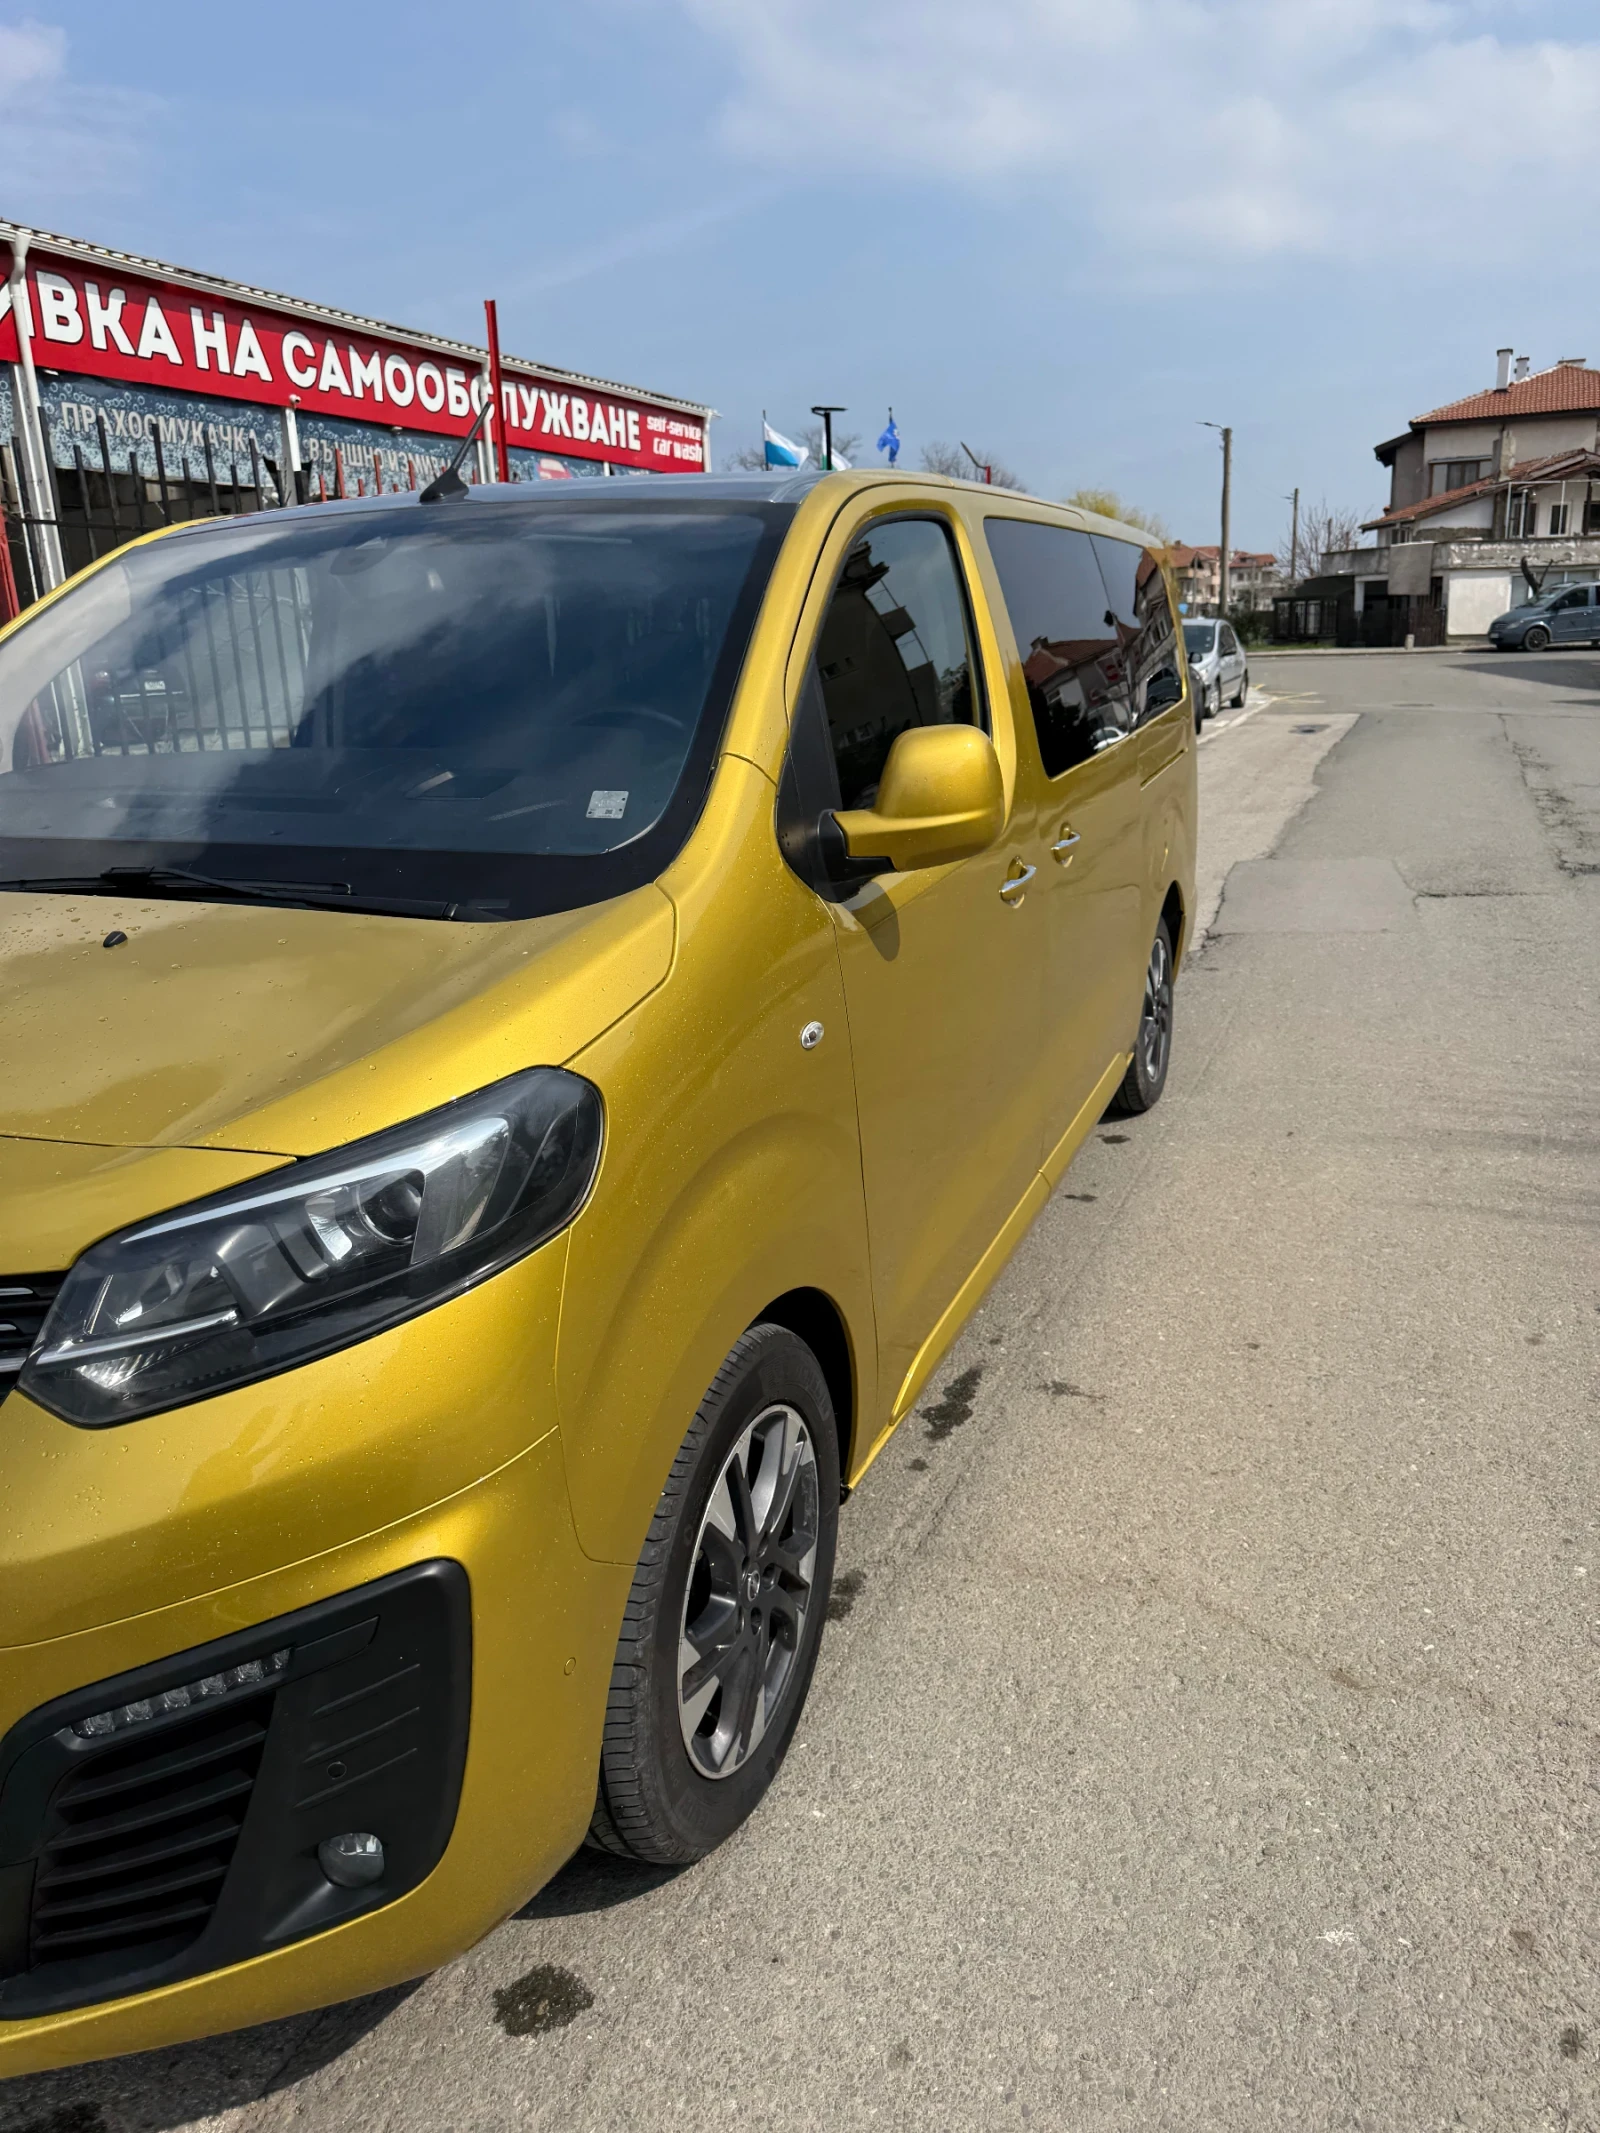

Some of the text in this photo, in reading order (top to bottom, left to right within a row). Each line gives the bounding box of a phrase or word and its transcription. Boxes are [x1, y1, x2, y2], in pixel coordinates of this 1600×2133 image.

[190, 306, 272, 382] НА
[282, 330, 641, 451] САМООБСЛУЖВАНЕ
[61, 402, 260, 454] ПРАХОСМУКАЧКА
[647, 415, 702, 441] self-service
[309, 437, 384, 470] ВЪНШНО
[653, 436, 703, 463] car wash
